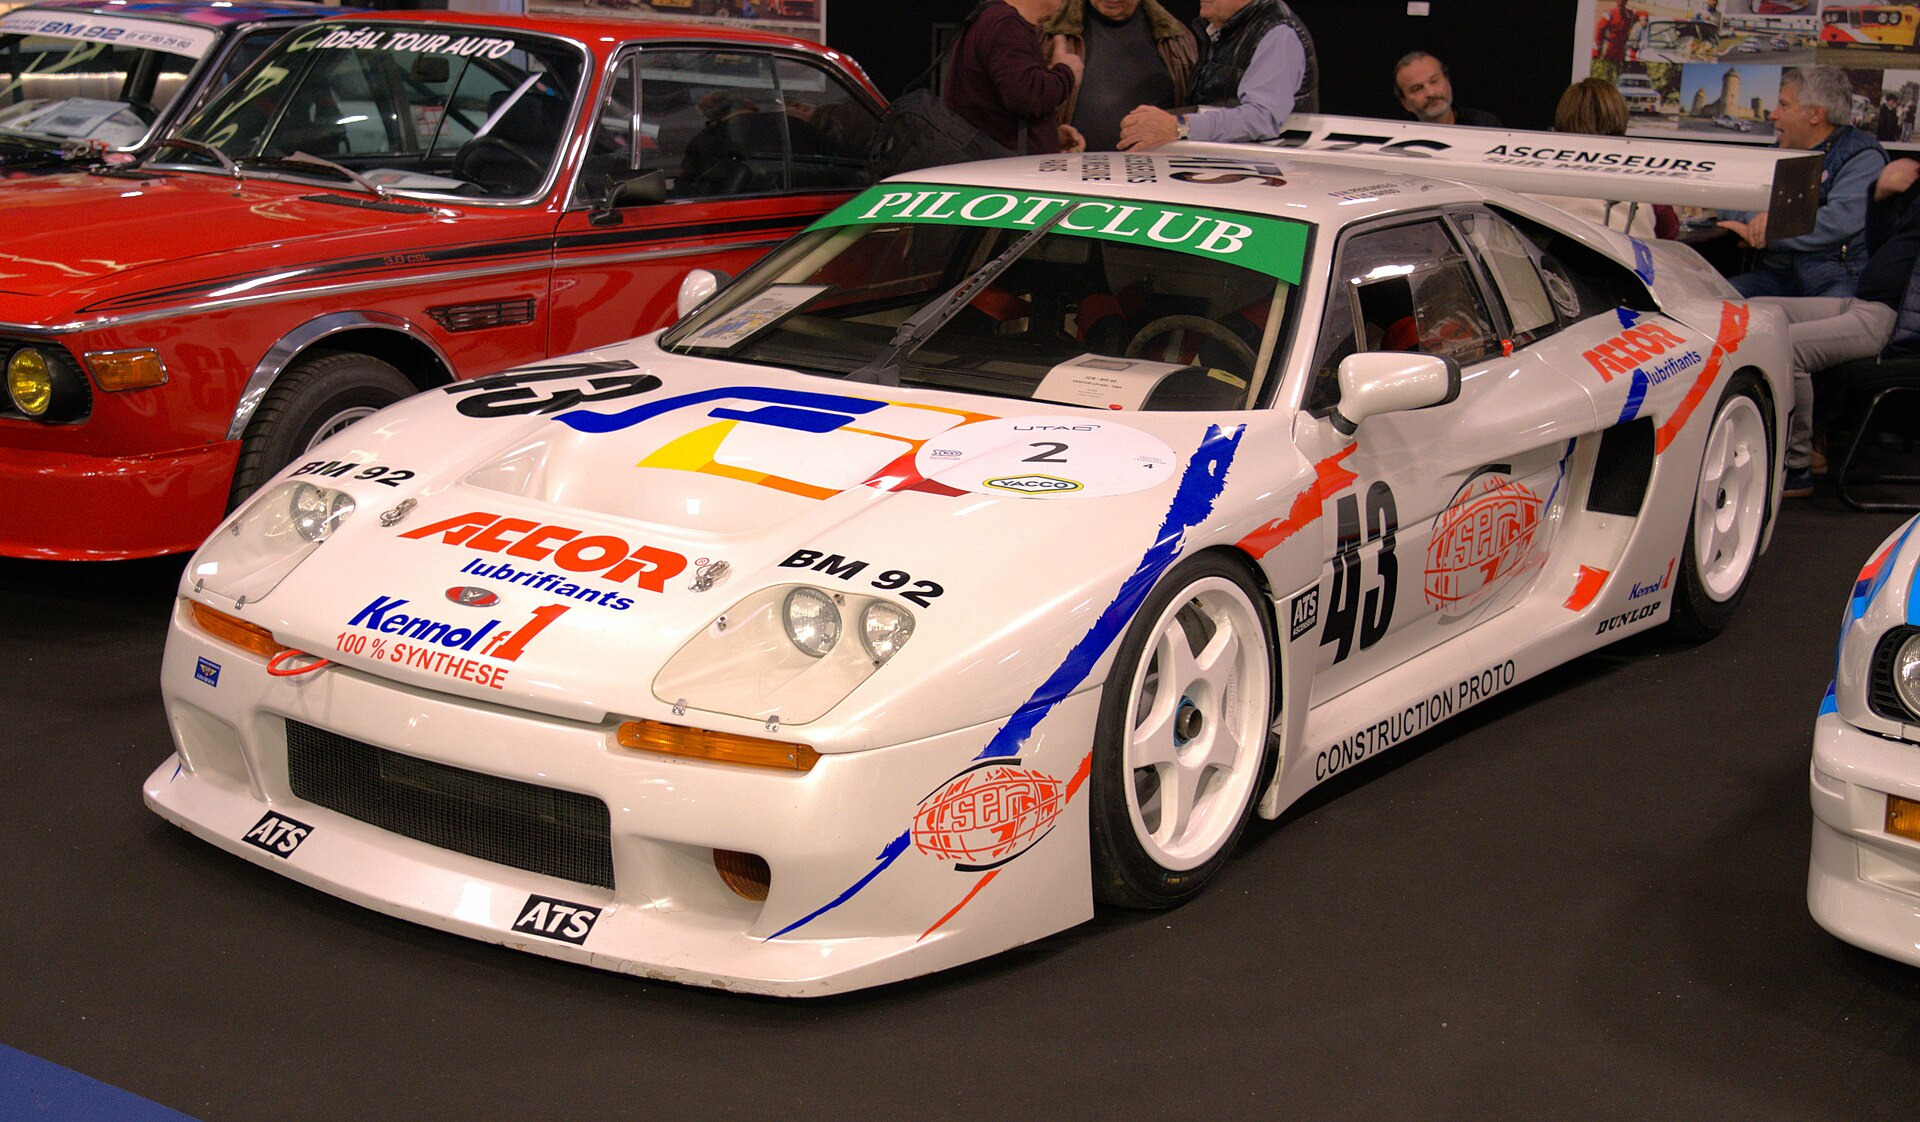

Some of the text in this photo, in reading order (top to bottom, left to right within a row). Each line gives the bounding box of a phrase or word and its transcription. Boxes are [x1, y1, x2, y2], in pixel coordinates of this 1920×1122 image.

[39, 21, 84, 35] BM
[83, 26, 126, 40] 92
[316, 27, 515, 59] IDÉAL TOUR AUTO
[1484, 145, 1716, 173] ASCENSEURS
[857, 191, 1253, 254] PILOTCLUB
[1582, 323, 1687, 384] ACCOR
[1645, 349, 1702, 387] lubrifiants
[442, 359, 663, 418] 43
[1021, 441, 1069, 464] 2
[287, 461, 416, 488] BM 92
[999, 479, 1069, 489] YACCO
[396, 512, 688, 594] ACCOR
[459, 558, 635, 611] lubrifiants
[777, 549, 944, 609] BM 92
[1319, 480, 1399, 666] 43
[1628, 574, 1663, 600] Kennol
[347, 595, 502, 652] Kennol
[1293, 591, 1317, 627] ATS
[1595, 601, 1661, 635] DUNLOP
[336, 631, 509, 690] 100 % SYNTHESE
[1315, 687, 1453, 781] CONSTRUCTION
[1458, 659, 1515, 708] PROTO
[247, 816, 307, 853] ATS
[515, 901, 597, 938] ATS
